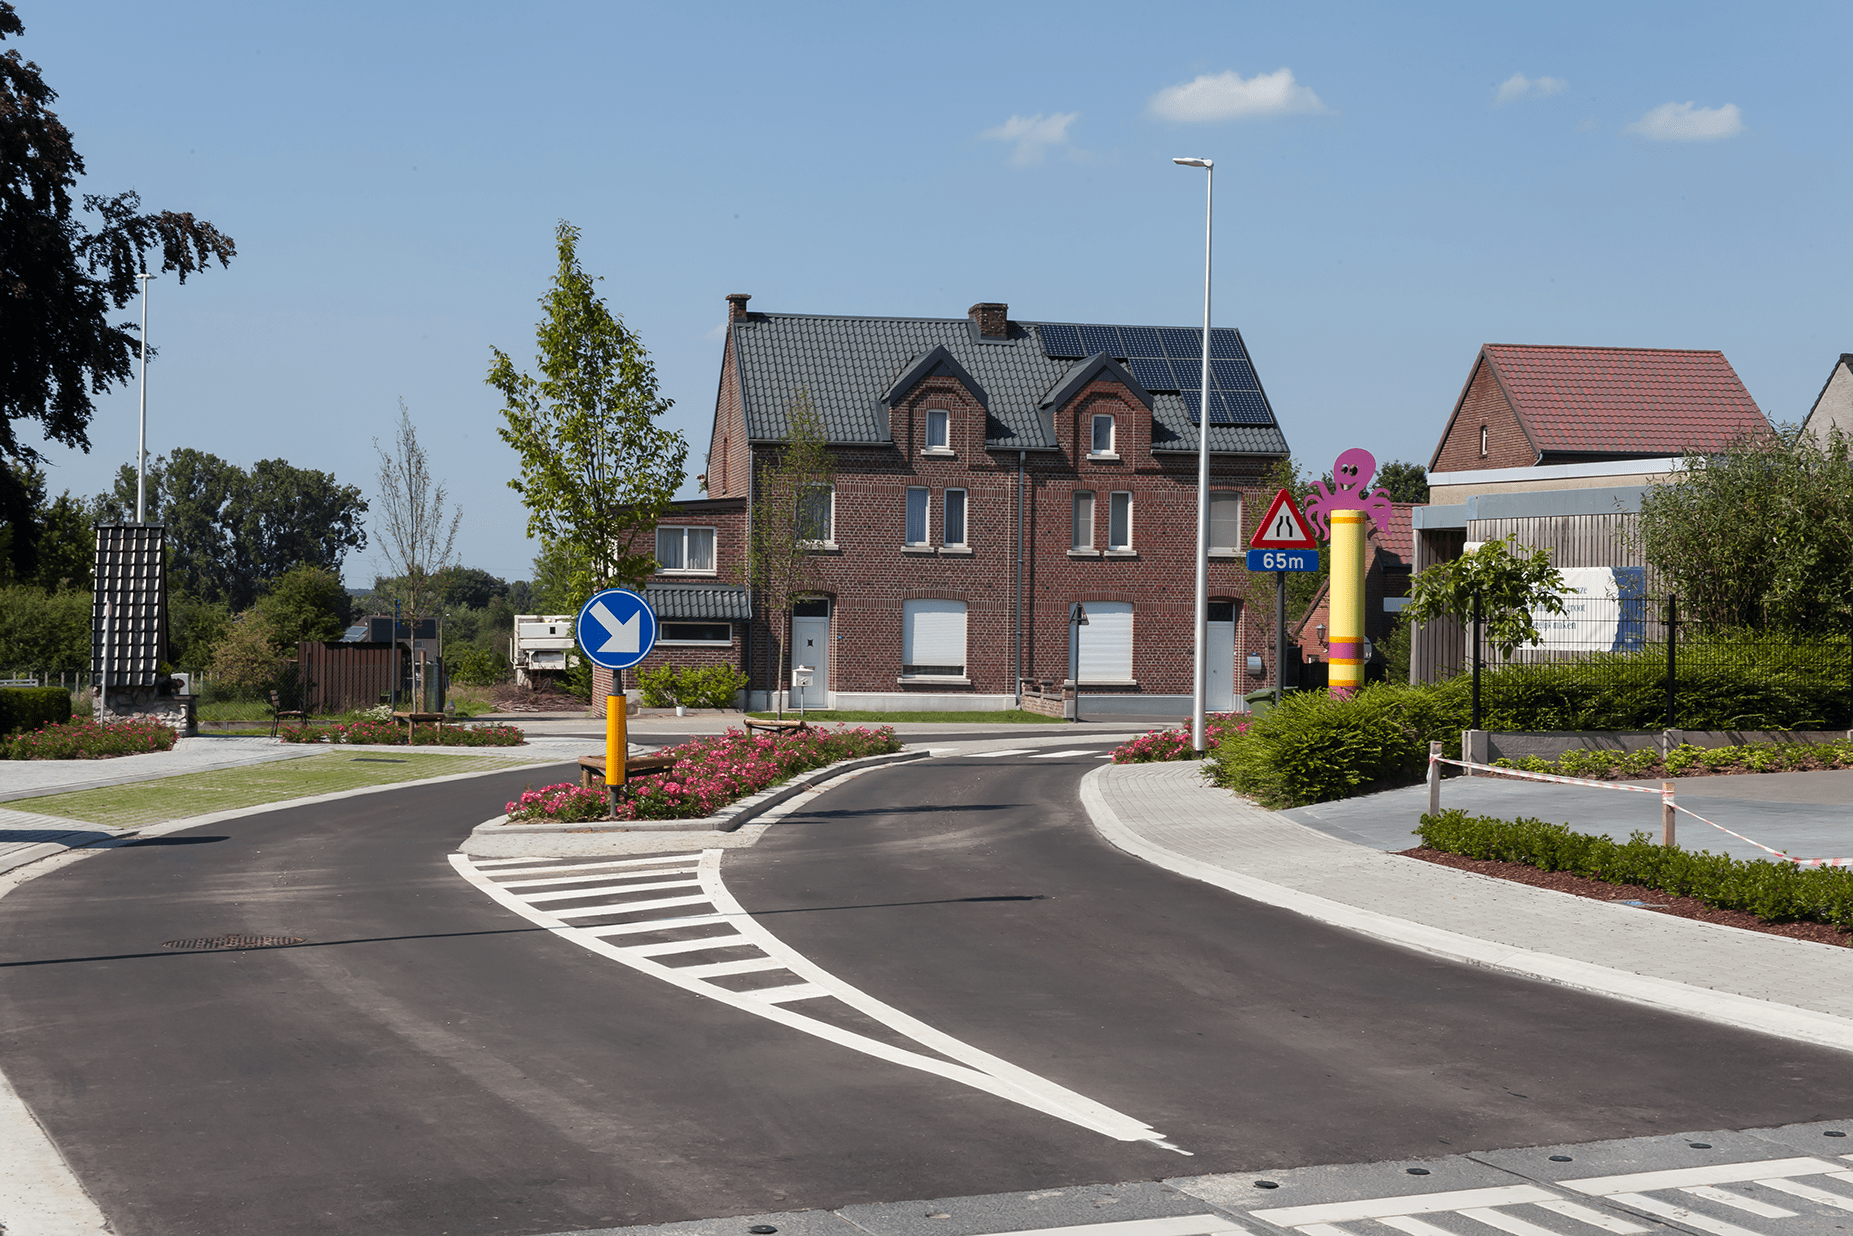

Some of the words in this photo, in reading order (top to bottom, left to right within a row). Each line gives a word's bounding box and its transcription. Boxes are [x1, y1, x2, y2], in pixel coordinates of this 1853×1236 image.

[1263, 553, 1303, 569] 65m
[1567, 602, 1586, 614] groot
[1553, 619, 1577, 630] maken
